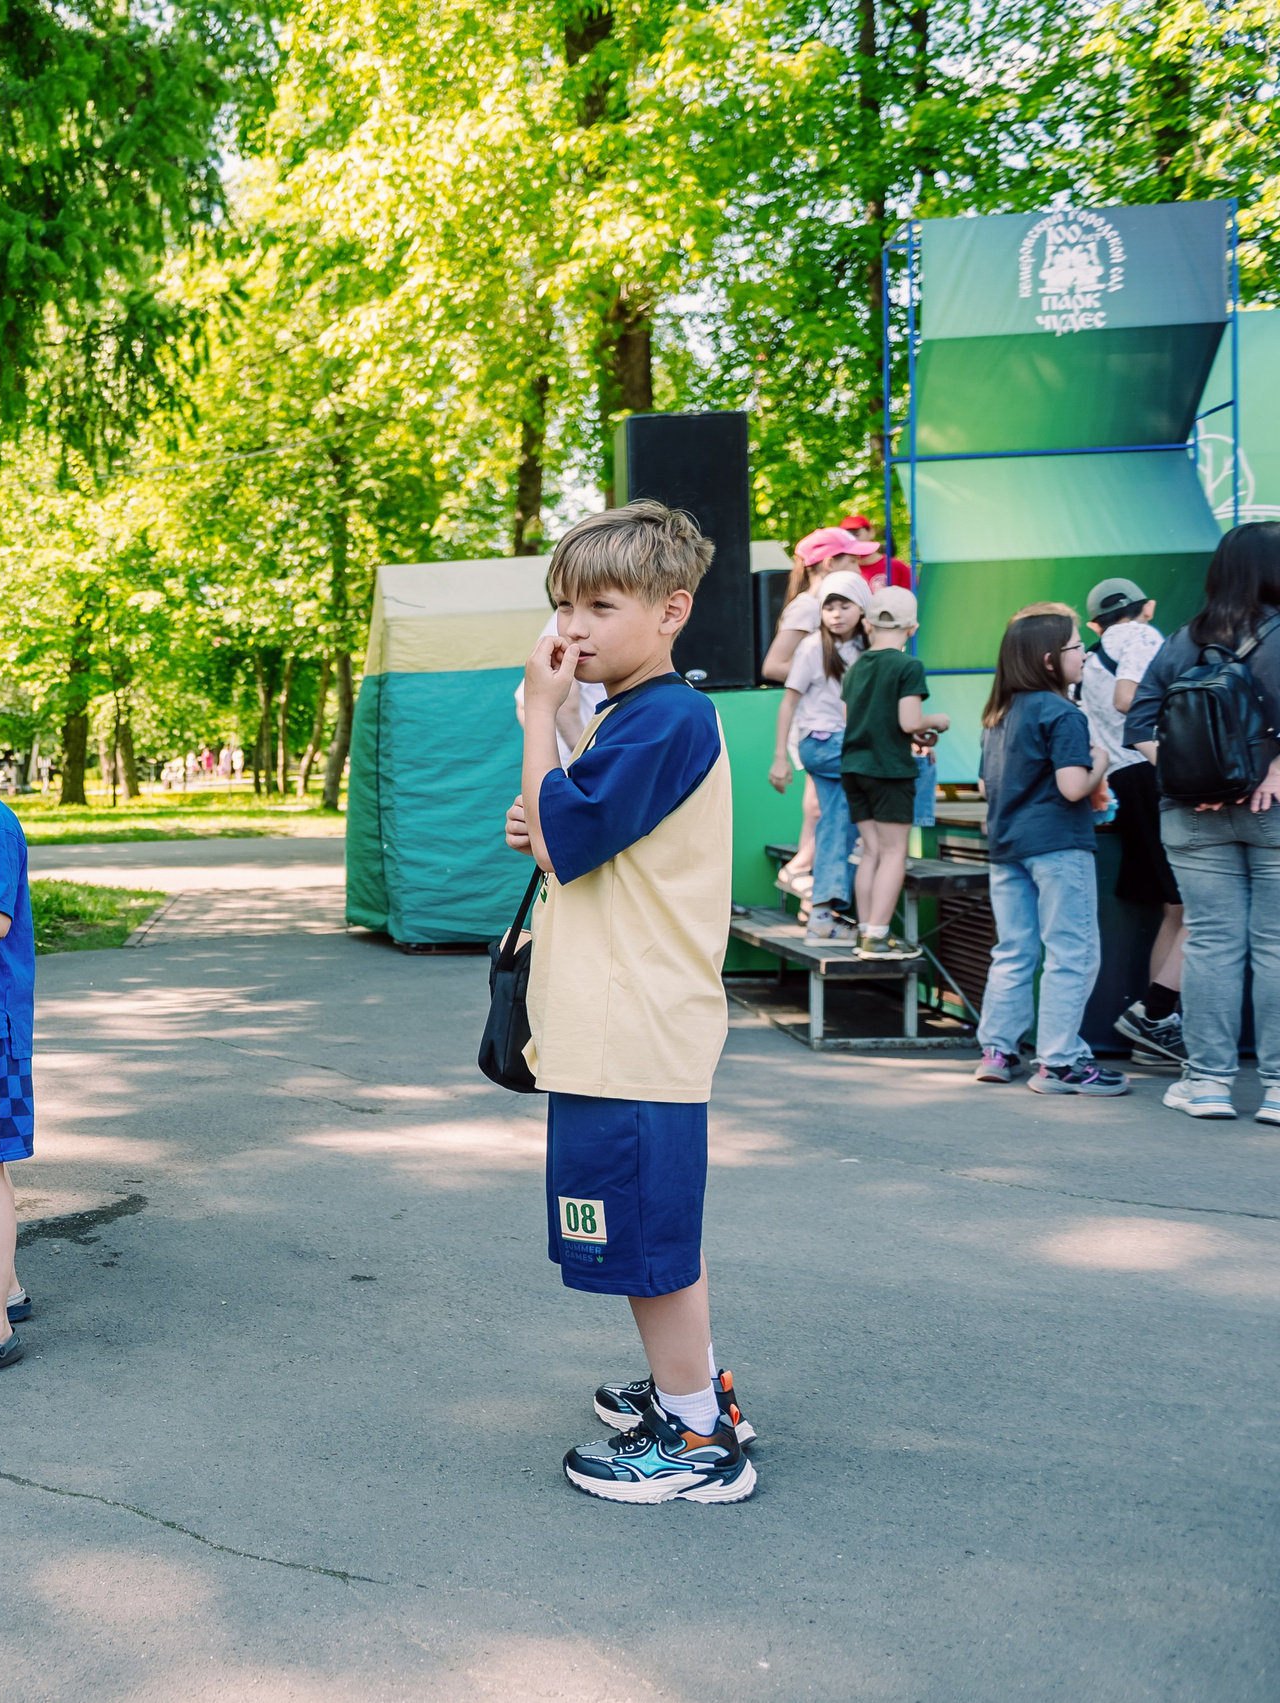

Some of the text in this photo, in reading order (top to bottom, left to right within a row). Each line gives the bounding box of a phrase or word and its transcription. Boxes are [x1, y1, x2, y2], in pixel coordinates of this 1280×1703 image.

[1046, 223, 1081, 245] 100
[565, 1201, 597, 1234] 08
[564, 1241, 602, 1255] SUMMER
[564, 1250, 594, 1263] GAMES
